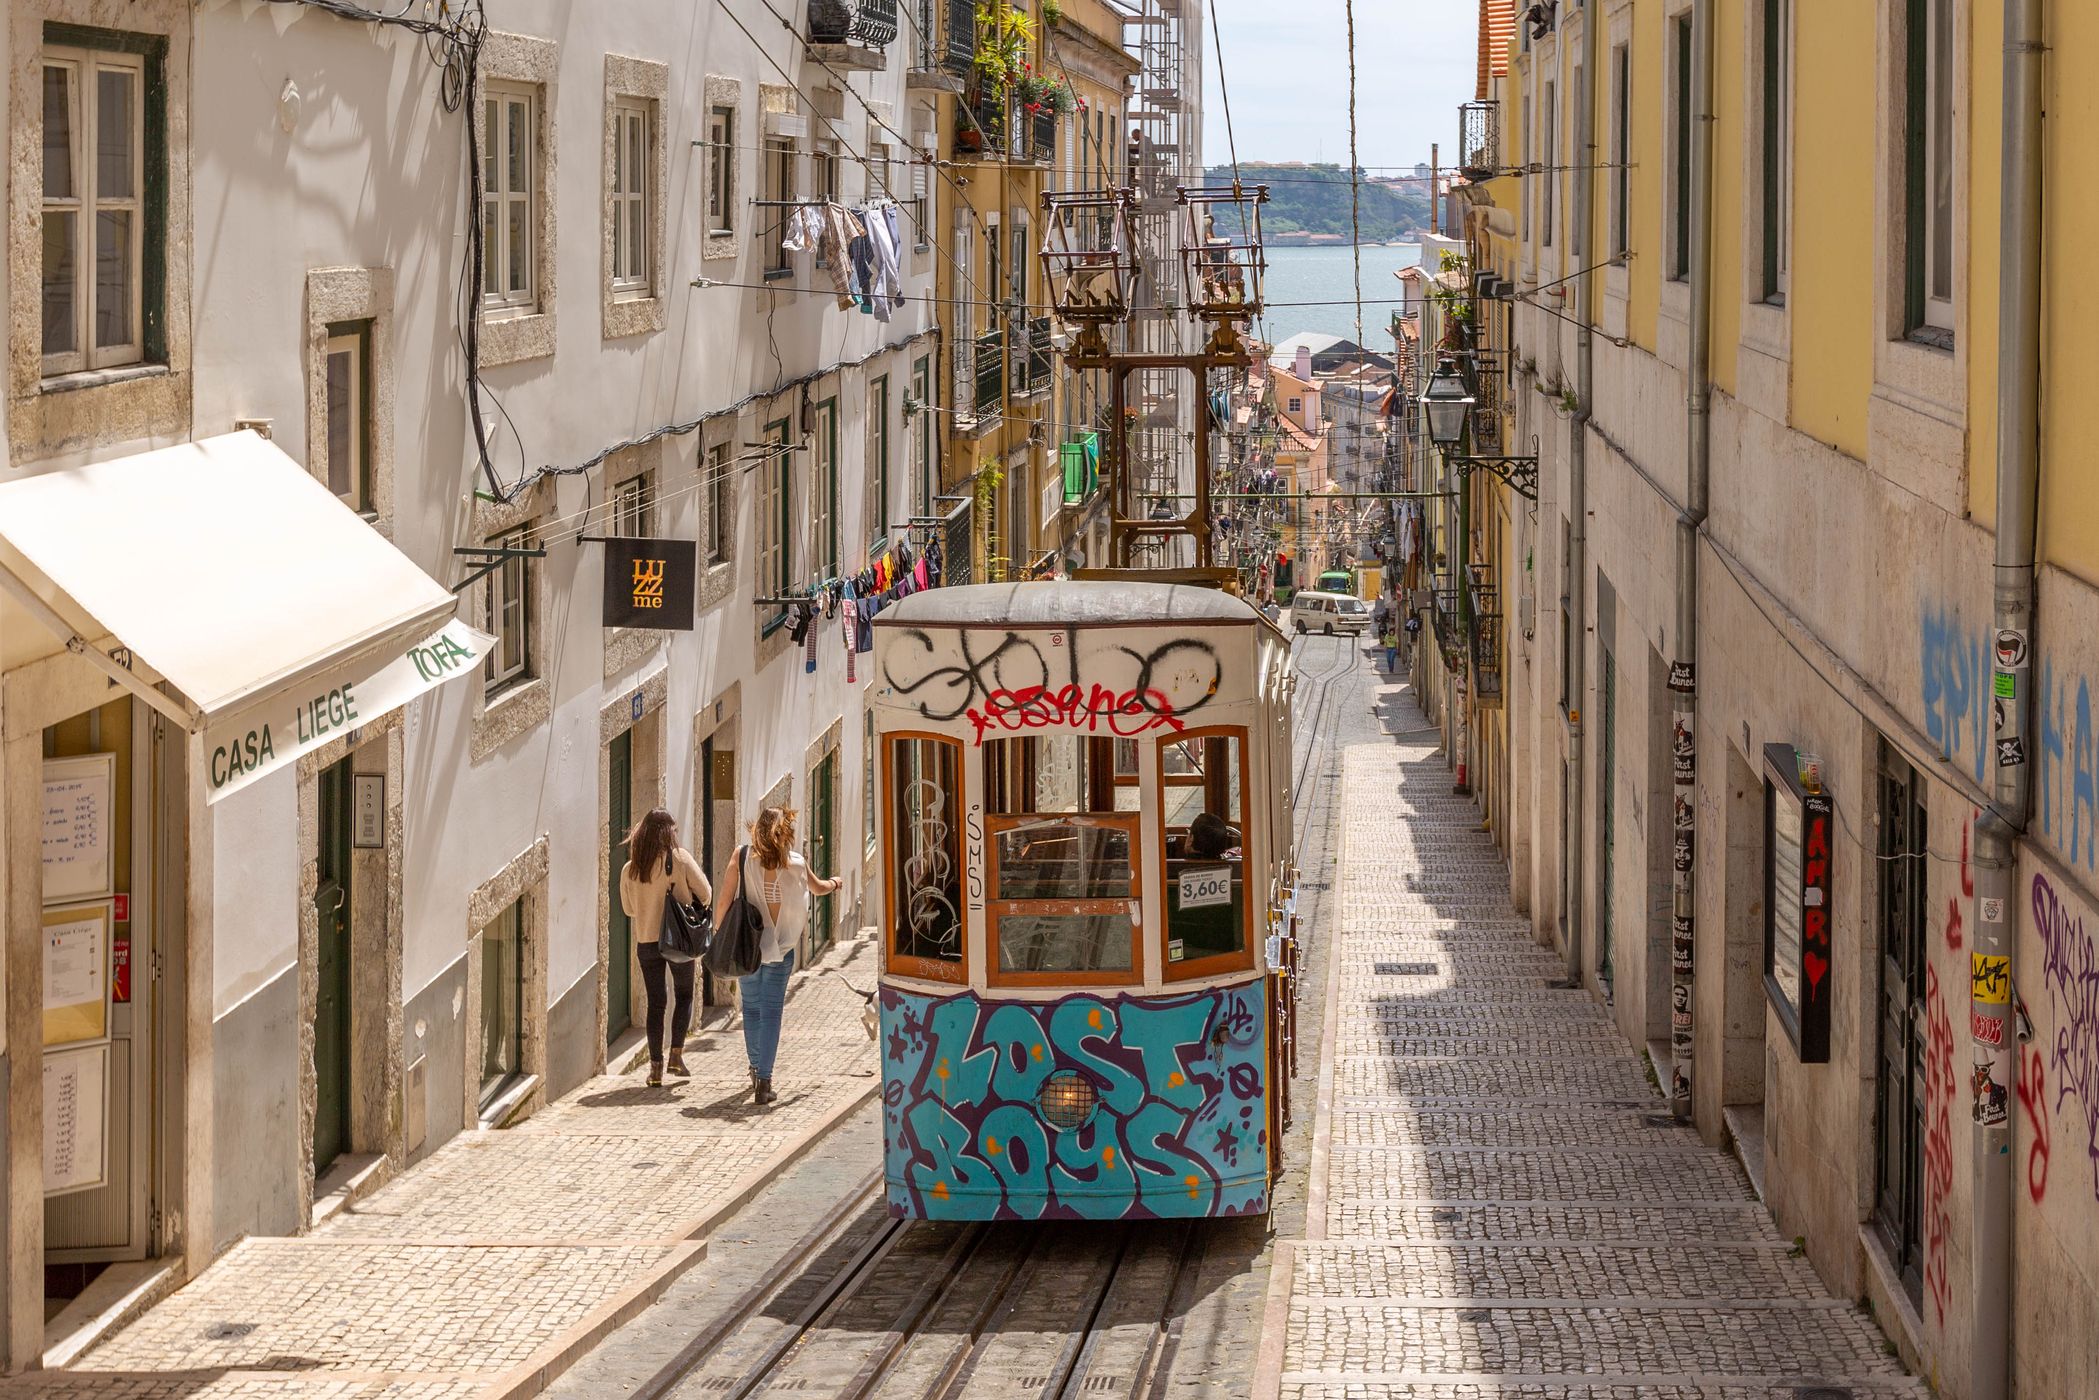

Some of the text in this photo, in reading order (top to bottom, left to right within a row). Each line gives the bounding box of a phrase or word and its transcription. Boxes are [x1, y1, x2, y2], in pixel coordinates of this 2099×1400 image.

[633, 576, 663, 596] ZZ
[633, 596, 662, 608] me
[407, 634, 477, 682] TOFA
[211, 682, 358, 789] CASA LIEGE
[1182, 880, 1228, 900] 3,60€
[911, 988, 1224, 1115] LOST
[904, 1100, 1222, 1221] BOYS
